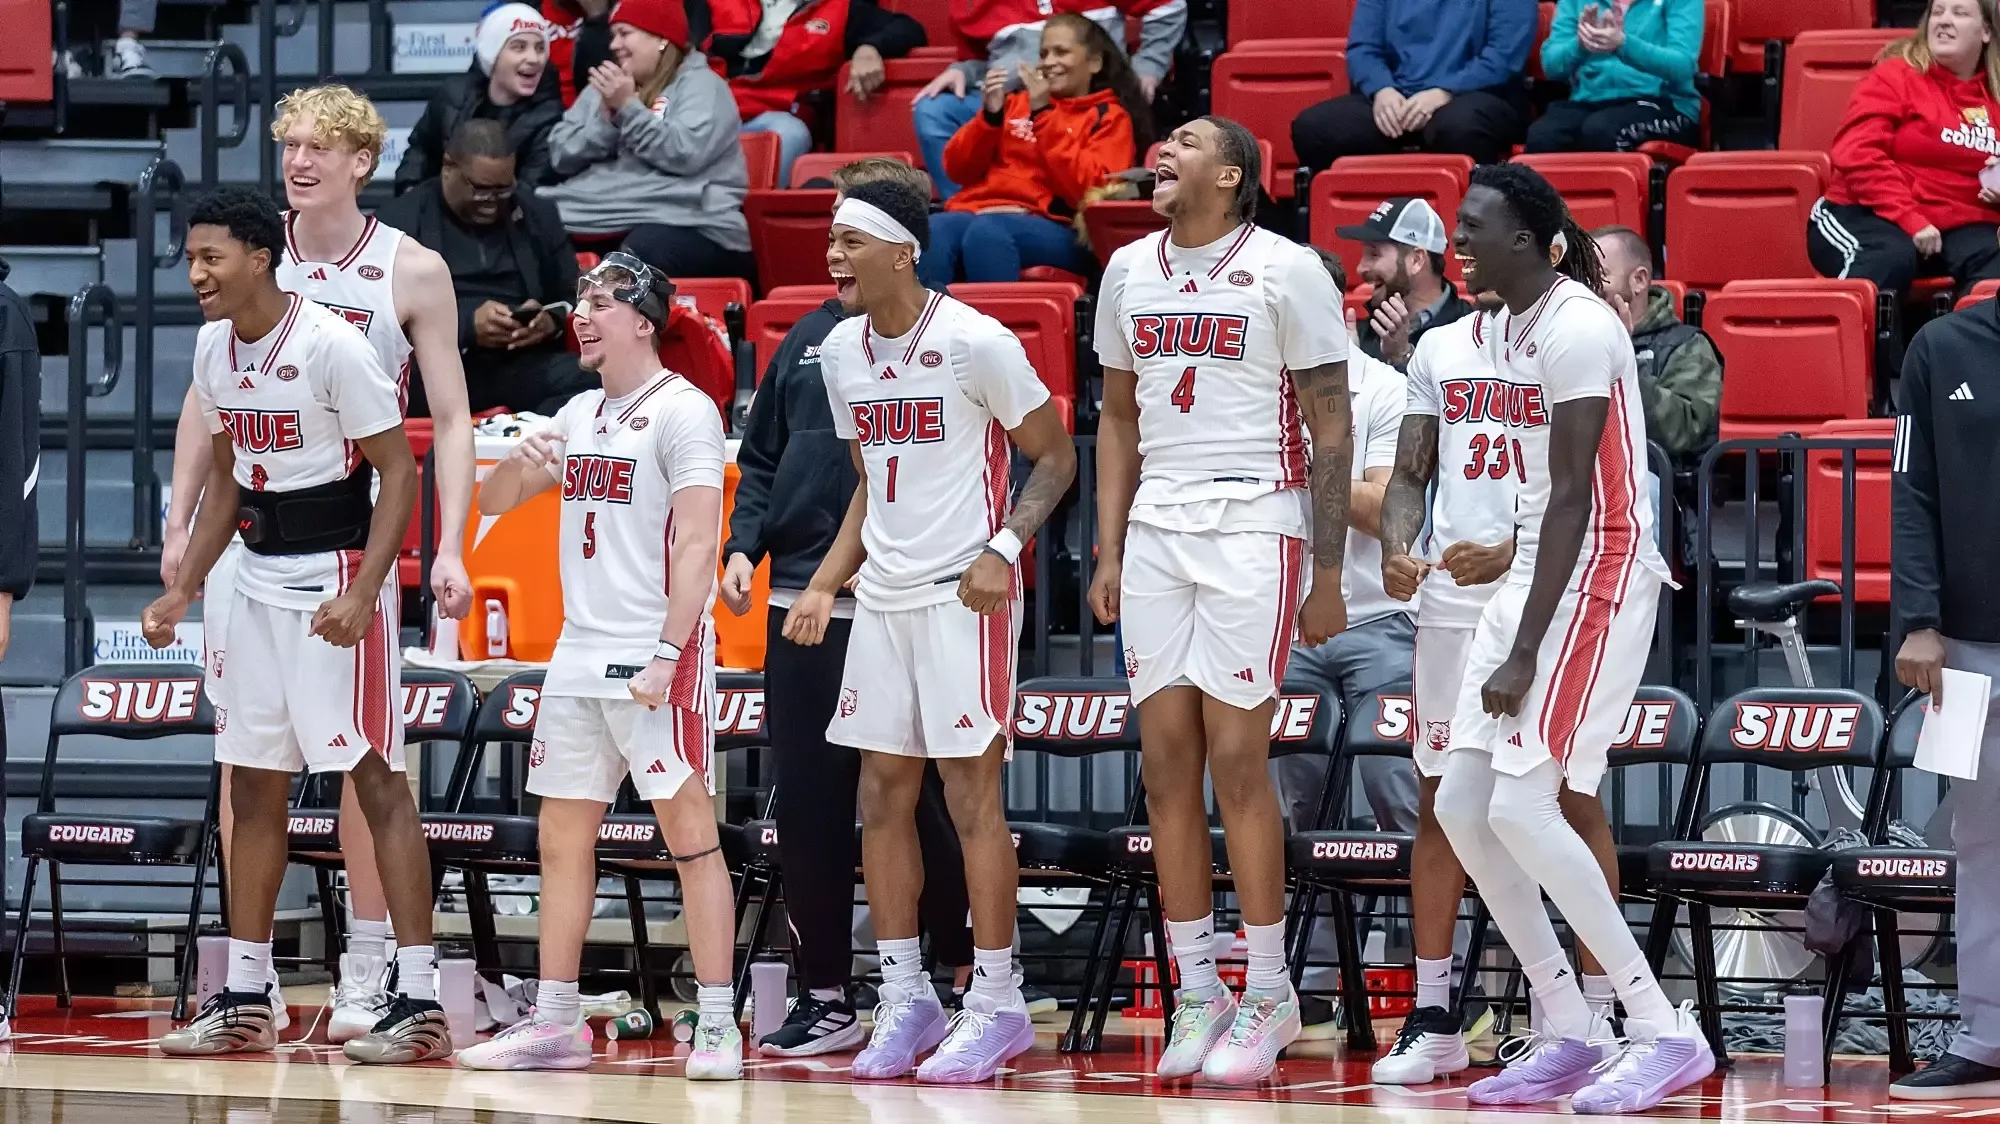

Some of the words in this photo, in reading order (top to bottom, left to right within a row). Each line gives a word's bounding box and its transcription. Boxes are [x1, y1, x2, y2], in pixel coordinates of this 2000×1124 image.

[1232, 274, 1249, 284] OVC
[1131, 313, 1249, 360] SIUE
[1171, 367, 1196, 413] 4
[218, 407, 303, 453] SIUE
[849, 397, 945, 446] SIUE
[1464, 434, 1509, 480] 33
[563, 454, 637, 504] SIUE
[886, 456, 899, 502] 1
[582, 511, 597, 560] 5
[95, 637, 198, 664] Community
[113, 630, 147, 647] Firs
[81, 679, 199, 721] SIUE
[401, 686, 451, 725] UE
[715, 692, 765, 731] UE
[1016, 695, 1131, 736] SIUE
[1612, 704, 1671, 744] UE
[1734, 706, 1859, 748] SIUE
[50, 825, 135, 843] COUGARS
[288, 818, 335, 833] GARS
[598, 824, 654, 840] UGARS
[1313, 841, 1399, 860] COUGARS
[1671, 853, 1759, 871] COUGARS
[1858, 859, 1947, 877] COUGARS
